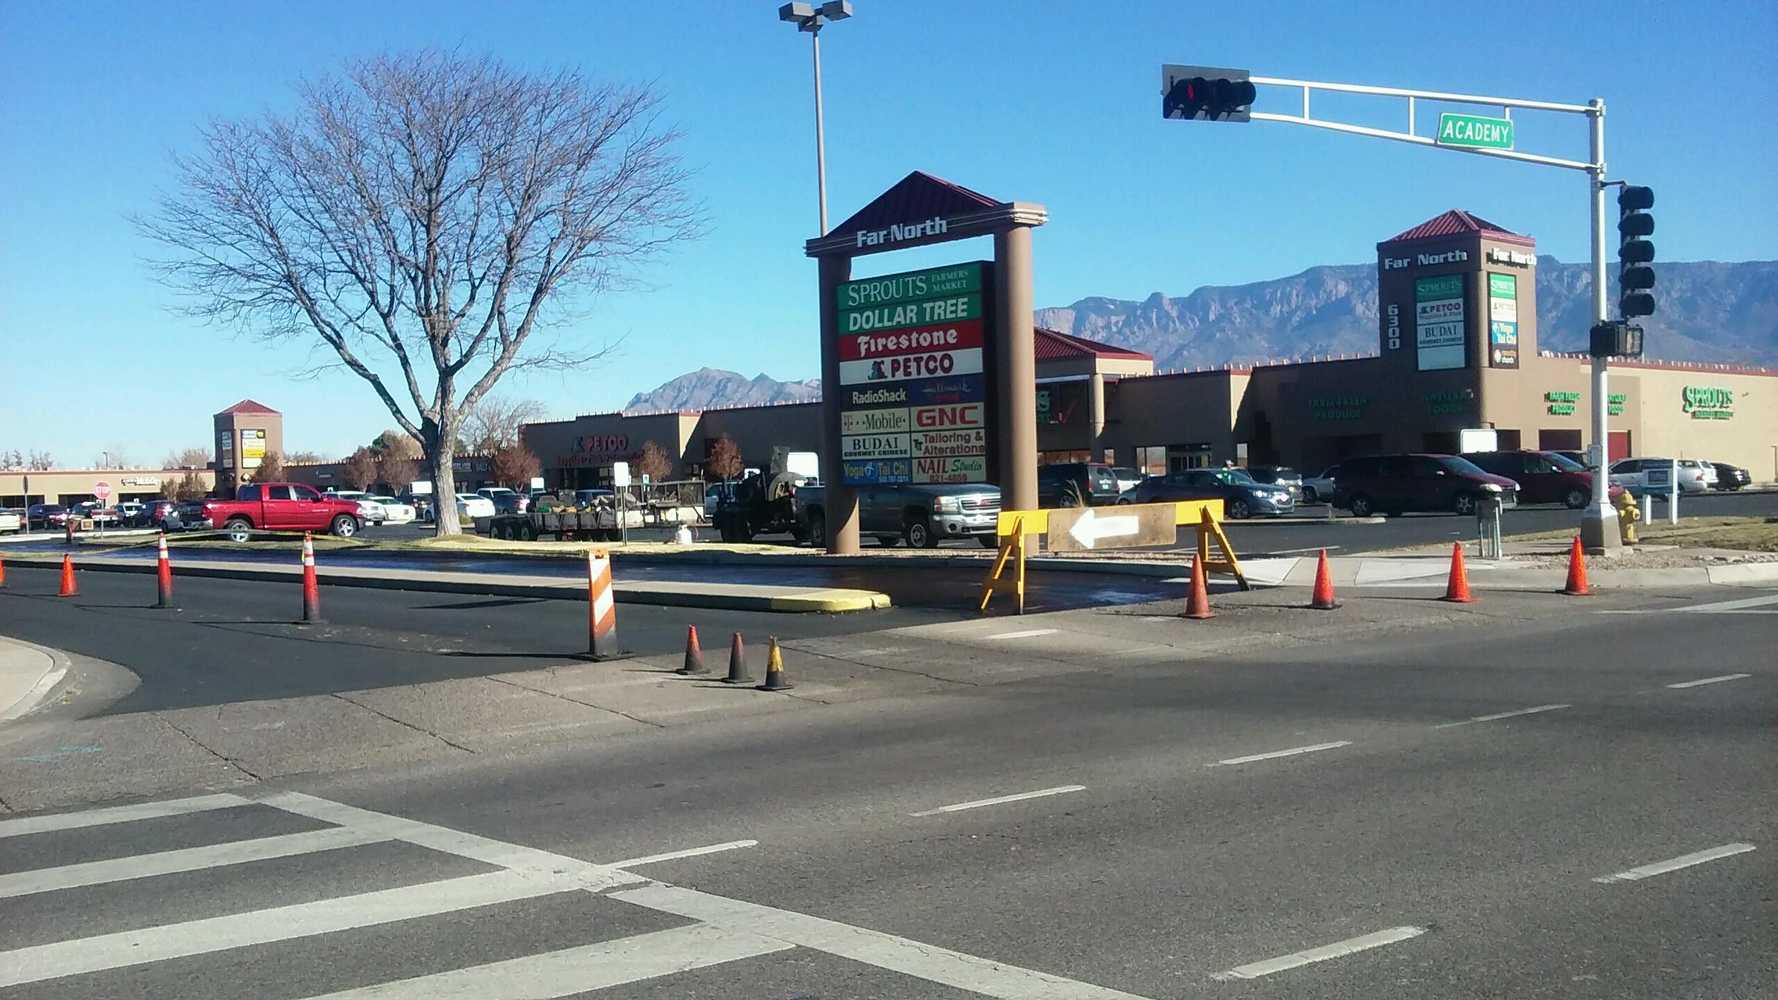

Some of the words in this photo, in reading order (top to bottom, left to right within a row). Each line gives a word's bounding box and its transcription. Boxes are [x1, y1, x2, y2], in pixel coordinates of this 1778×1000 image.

[1443, 120, 1508, 143] ACADEMY
[857, 229, 887, 248] Far
[890, 217, 947, 241] North
[1385, 257, 1411, 270] Far
[1418, 250, 1467, 266] North
[848, 276, 927, 306] SPROUTS
[849, 305, 917, 331] DOLLAR
[923, 298, 968, 321] TREE
[1430, 303, 1461, 312] PETCO
[857, 329, 958, 357] Firestone
[891, 353, 953, 378] PETCO
[852, 388, 906, 404] RadioShack
[1683, 385, 1733, 412] SPROUTS
[917, 406, 978, 427] GNC
[853, 437, 898, 450] BUDAI
[923, 432, 971, 445] Tailoring
[975, 431, 983, 441] &
[923, 444, 984, 456] Alterations
[917, 459, 949, 475] NAIL
